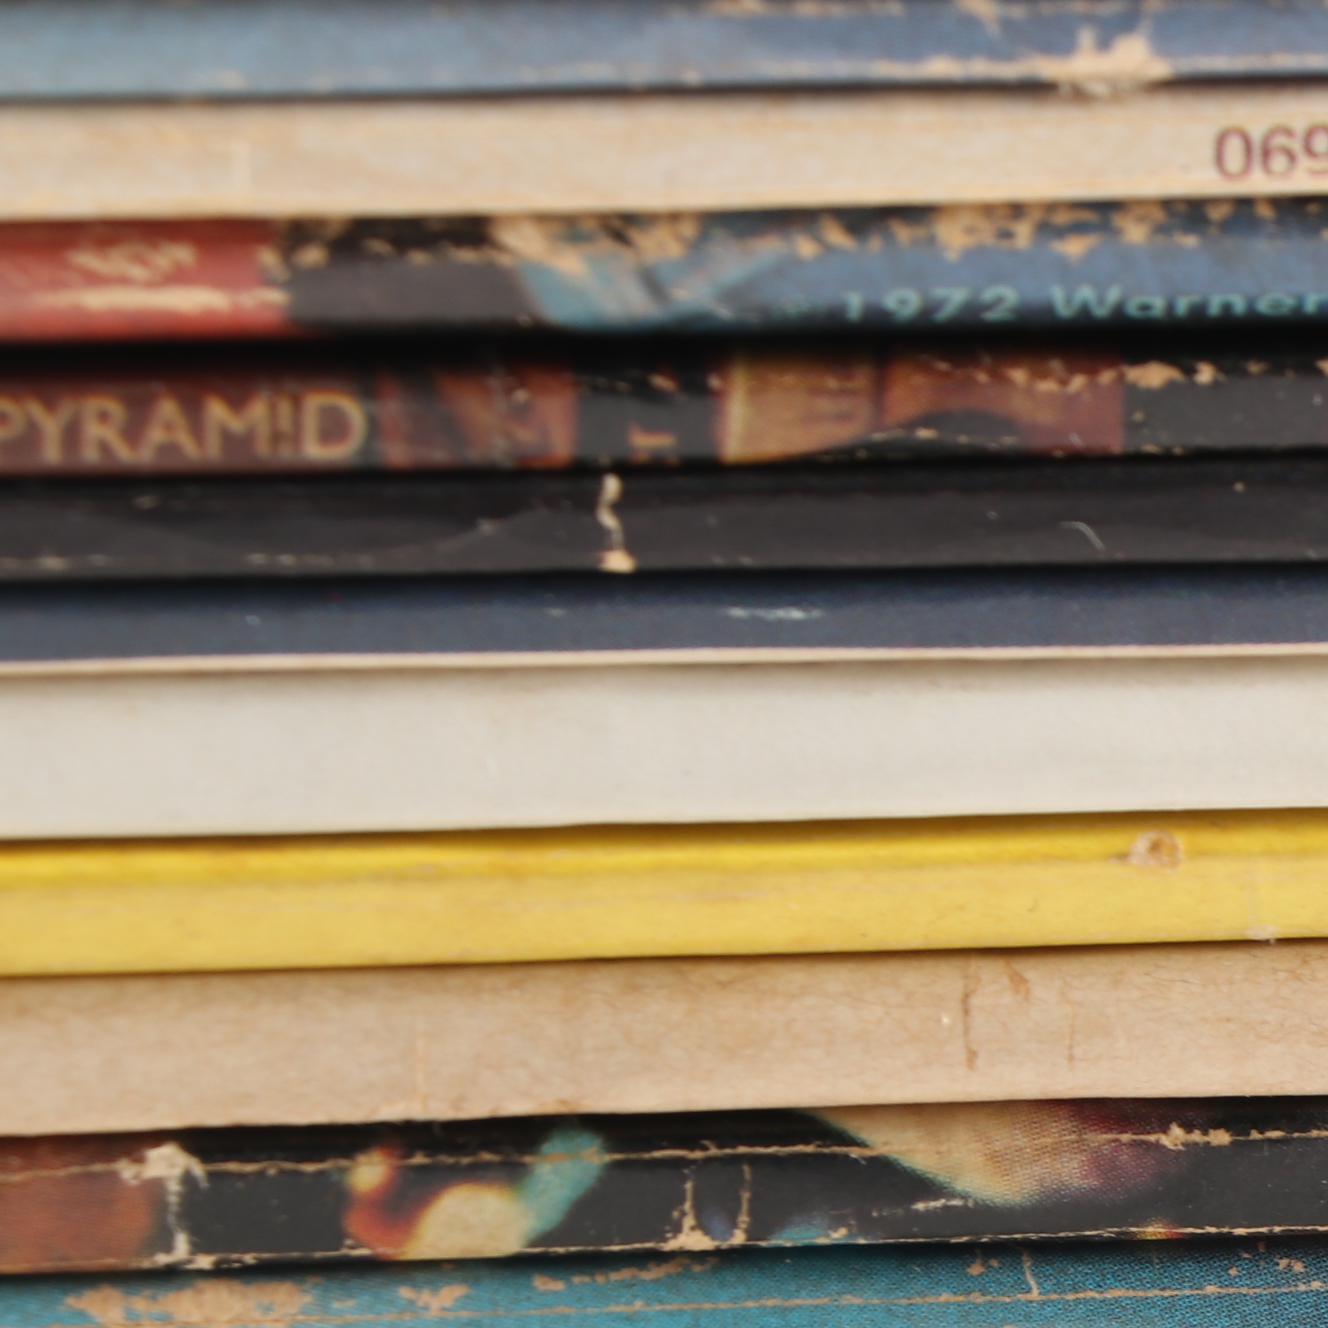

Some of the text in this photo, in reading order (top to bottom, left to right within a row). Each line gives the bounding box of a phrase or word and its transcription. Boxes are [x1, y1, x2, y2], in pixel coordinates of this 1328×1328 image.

[842, 284, 1018, 323] 1972
[1049, 281, 1328, 320] Warner
[0, 390, 368, 465] PYRAMID
